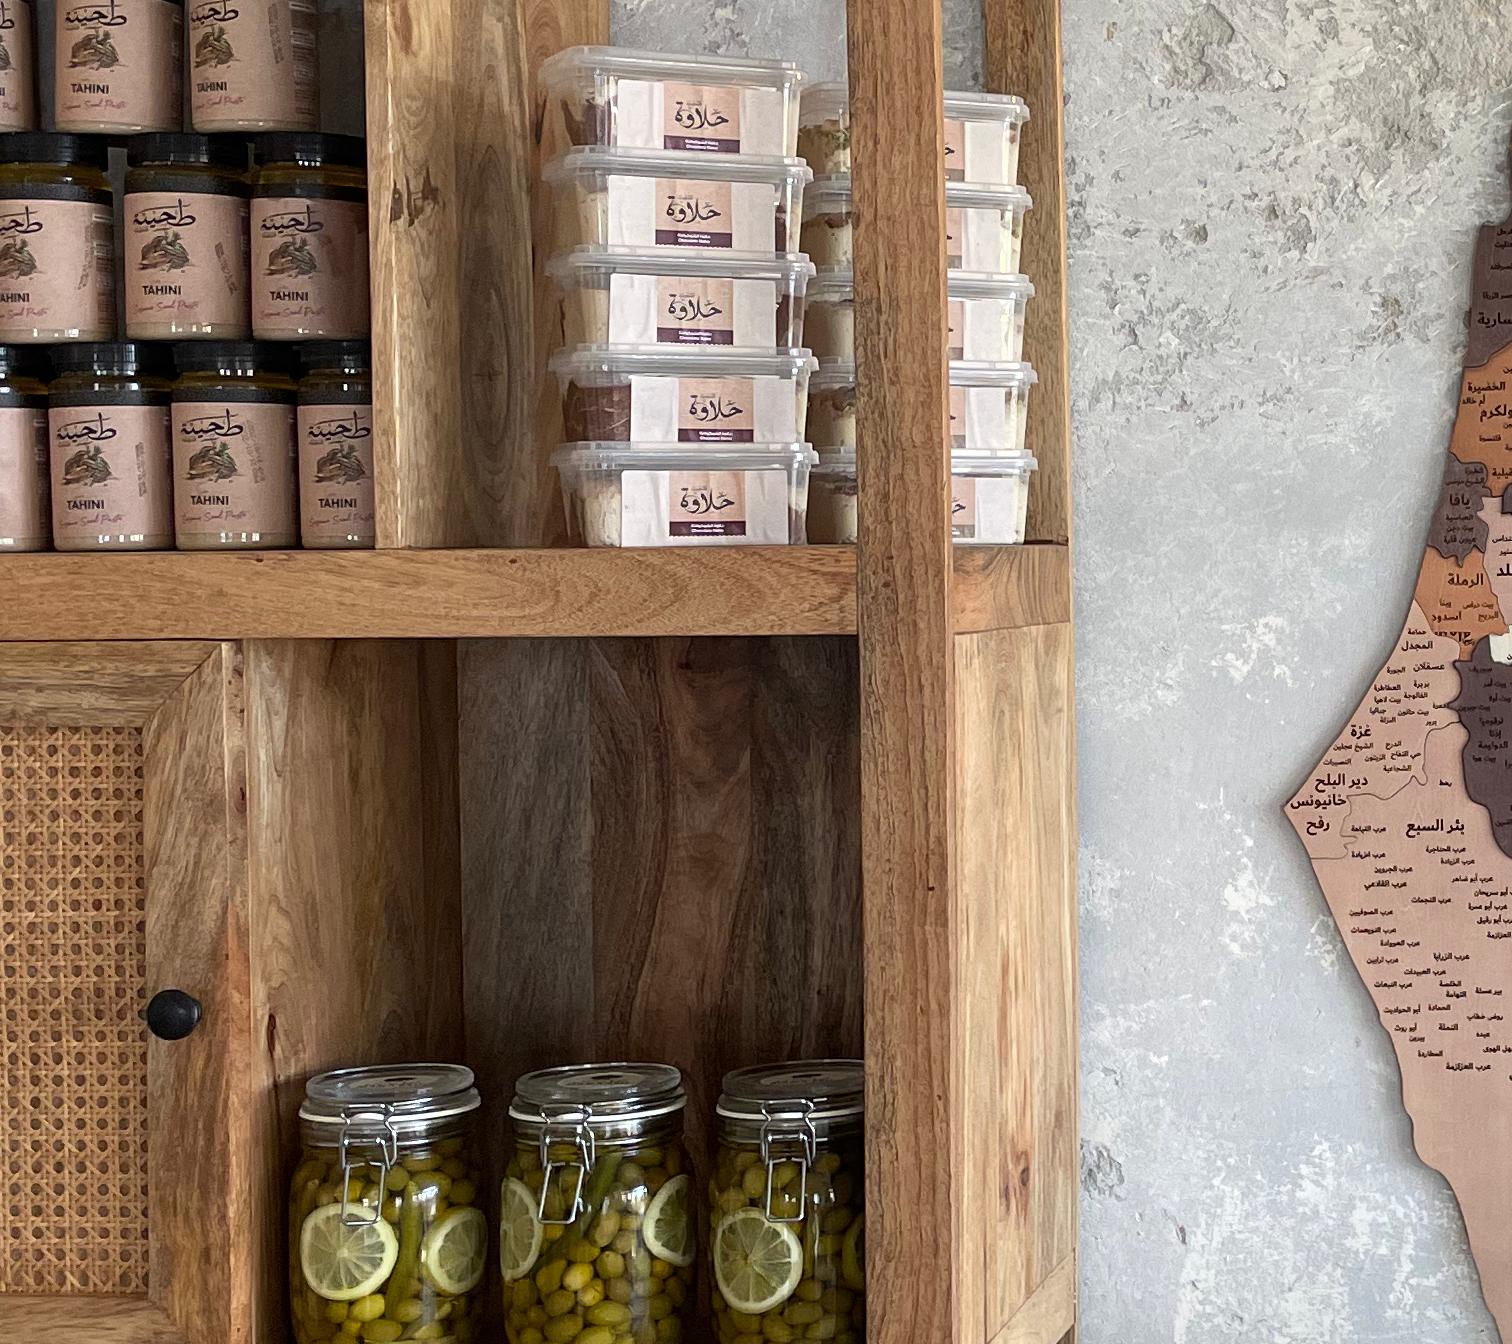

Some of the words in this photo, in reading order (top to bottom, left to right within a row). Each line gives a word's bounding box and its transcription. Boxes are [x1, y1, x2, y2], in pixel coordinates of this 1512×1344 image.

[71, 83, 110, 94] TAHINI
[197, 81, 228, 93] TAHINI
[0, 206, 43, 235] طحي
[142, 285, 182, 296] TAHINI
[269, 291, 309, 302] TAHINI
[0, 292, 30, 303] AHINI
[1467, 381, 1507, 394] الخضيرة
[67, 499, 105, 510] TAHINI
[190, 495, 230, 506] TAHINI
[318, 498, 358, 509] TAHINI
[1449, 493, 1471, 509] يافا
[1447, 573, 1484, 589] الرملة
[1401, 640, 1434, 653] المجدل
[1412, 661, 1445, 673] عسقلان
[1350, 724, 1372, 739] غزة
[1314, 773, 1346, 793] البلح
[1348, 777, 1369, 789] دير
[1290, 793, 1347, 810] خانيونس
[1306, 815, 1331, 835] رفح
[1405, 818, 1444, 838] السبع
[1446, 818, 1466, 836] بئر
